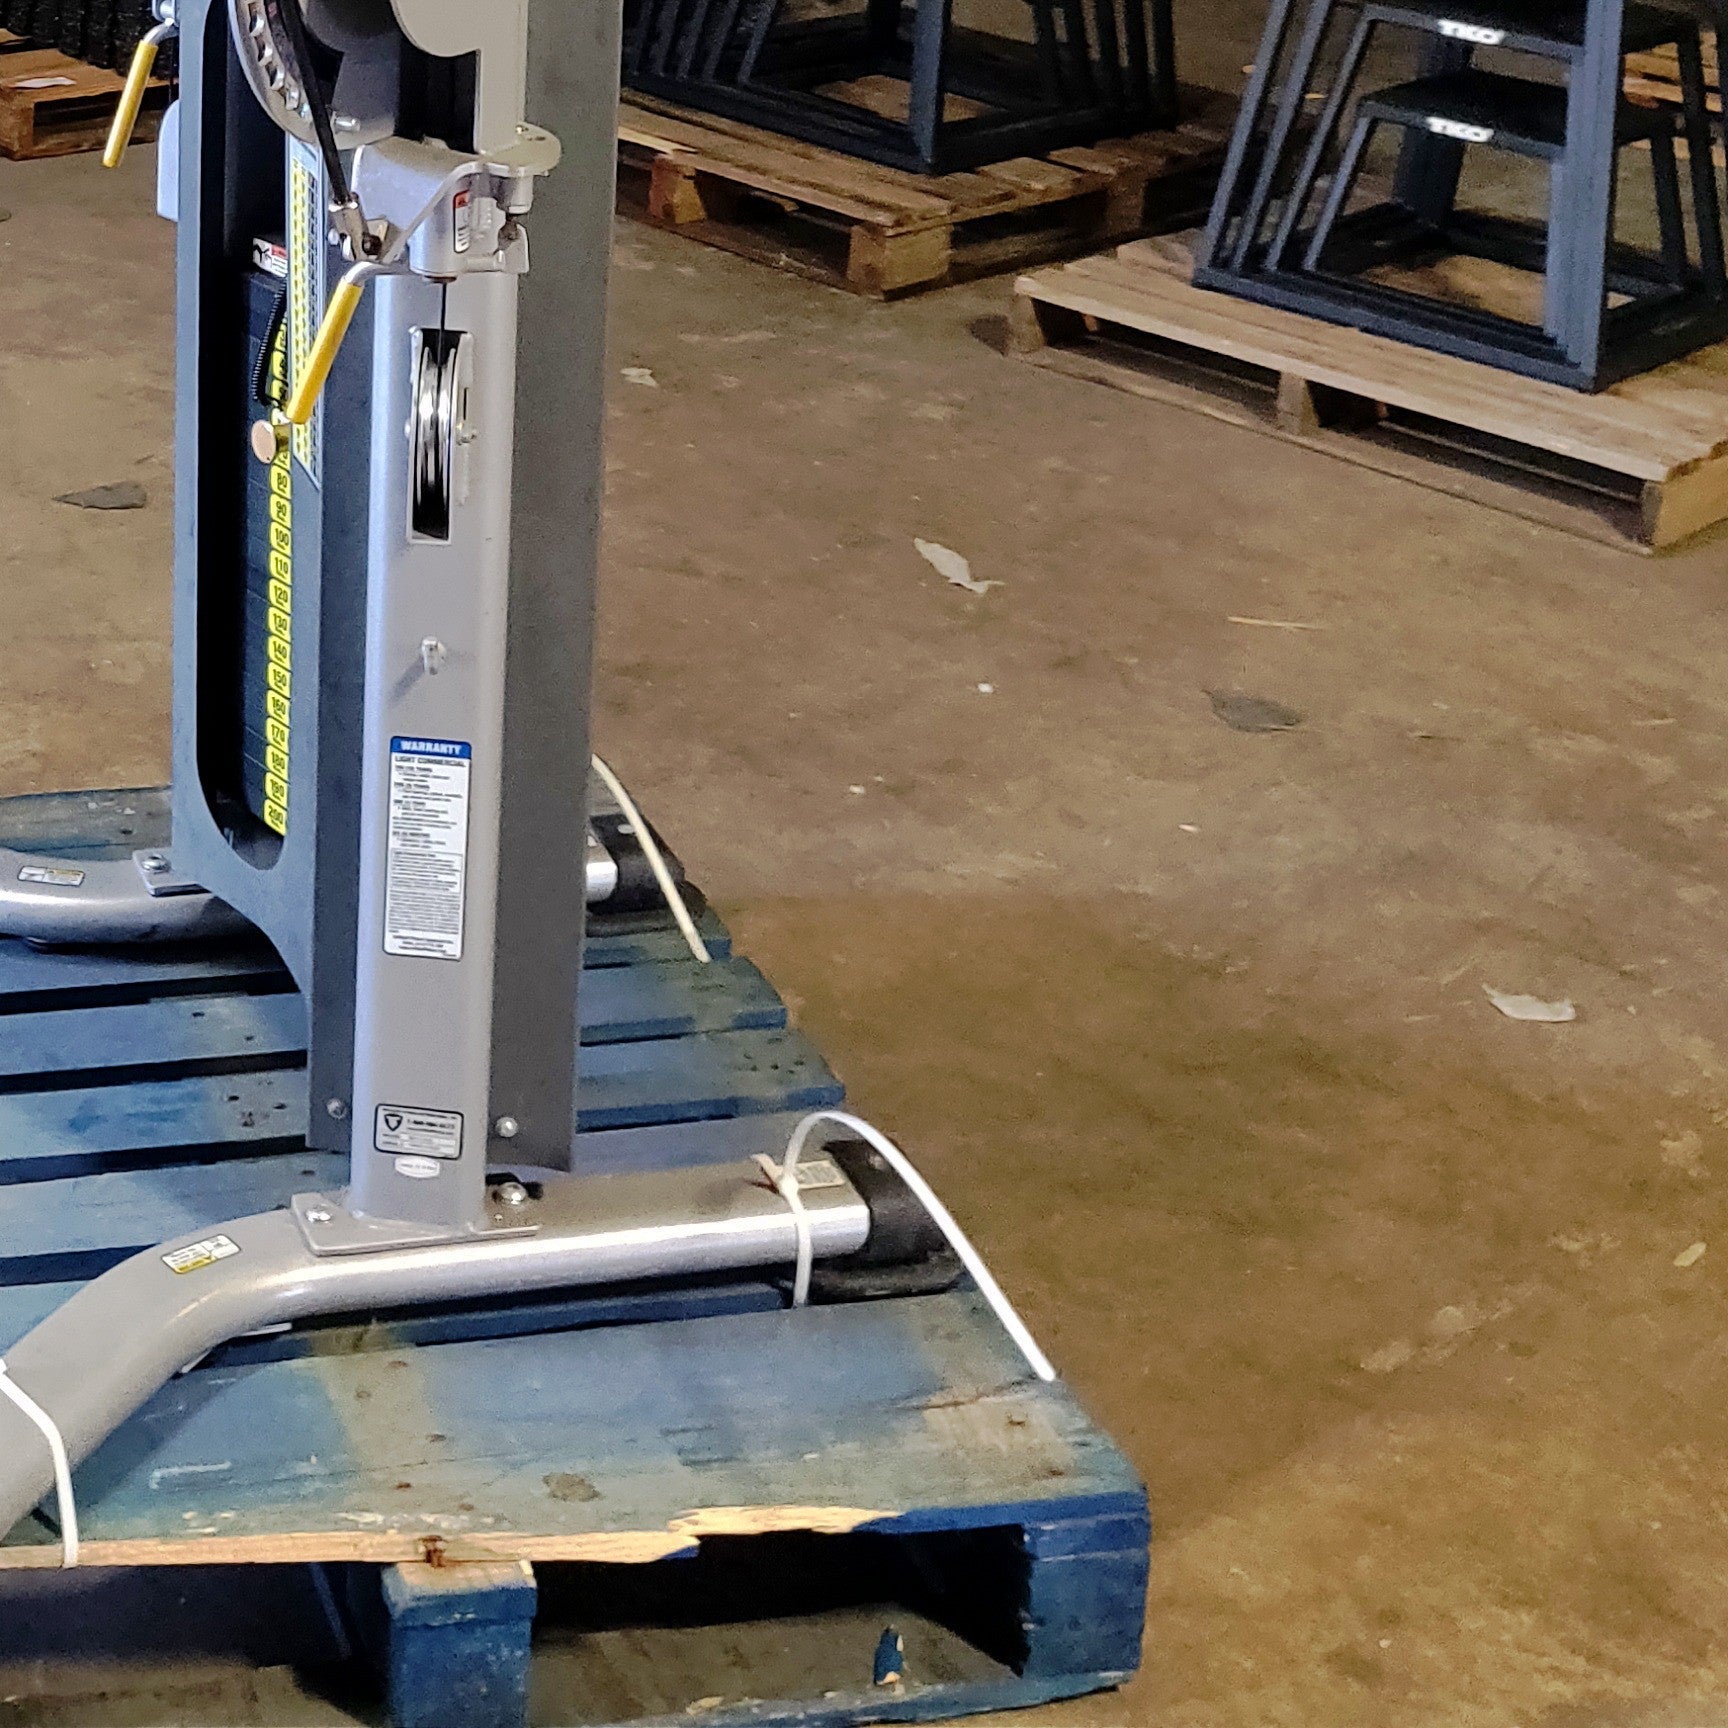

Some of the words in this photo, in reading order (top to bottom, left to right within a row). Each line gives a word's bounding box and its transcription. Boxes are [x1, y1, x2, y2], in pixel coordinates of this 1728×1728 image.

[1437, 19, 1506, 46] TKO
[1426, 115, 1495, 144] TKO
[276, 500, 287, 517] 90
[275, 528, 290, 546] 100
[274, 556, 289, 575] 110
[273, 585, 289, 603] 120
[273, 613, 288, 631] 130
[272, 640, 288, 659] 140
[272, 668, 287, 687] 150
[271, 696, 286, 715] 160
[270, 723, 285, 743] 170
[400, 740, 463, 755] WARRANTY
[271, 751, 286, 770] 180
